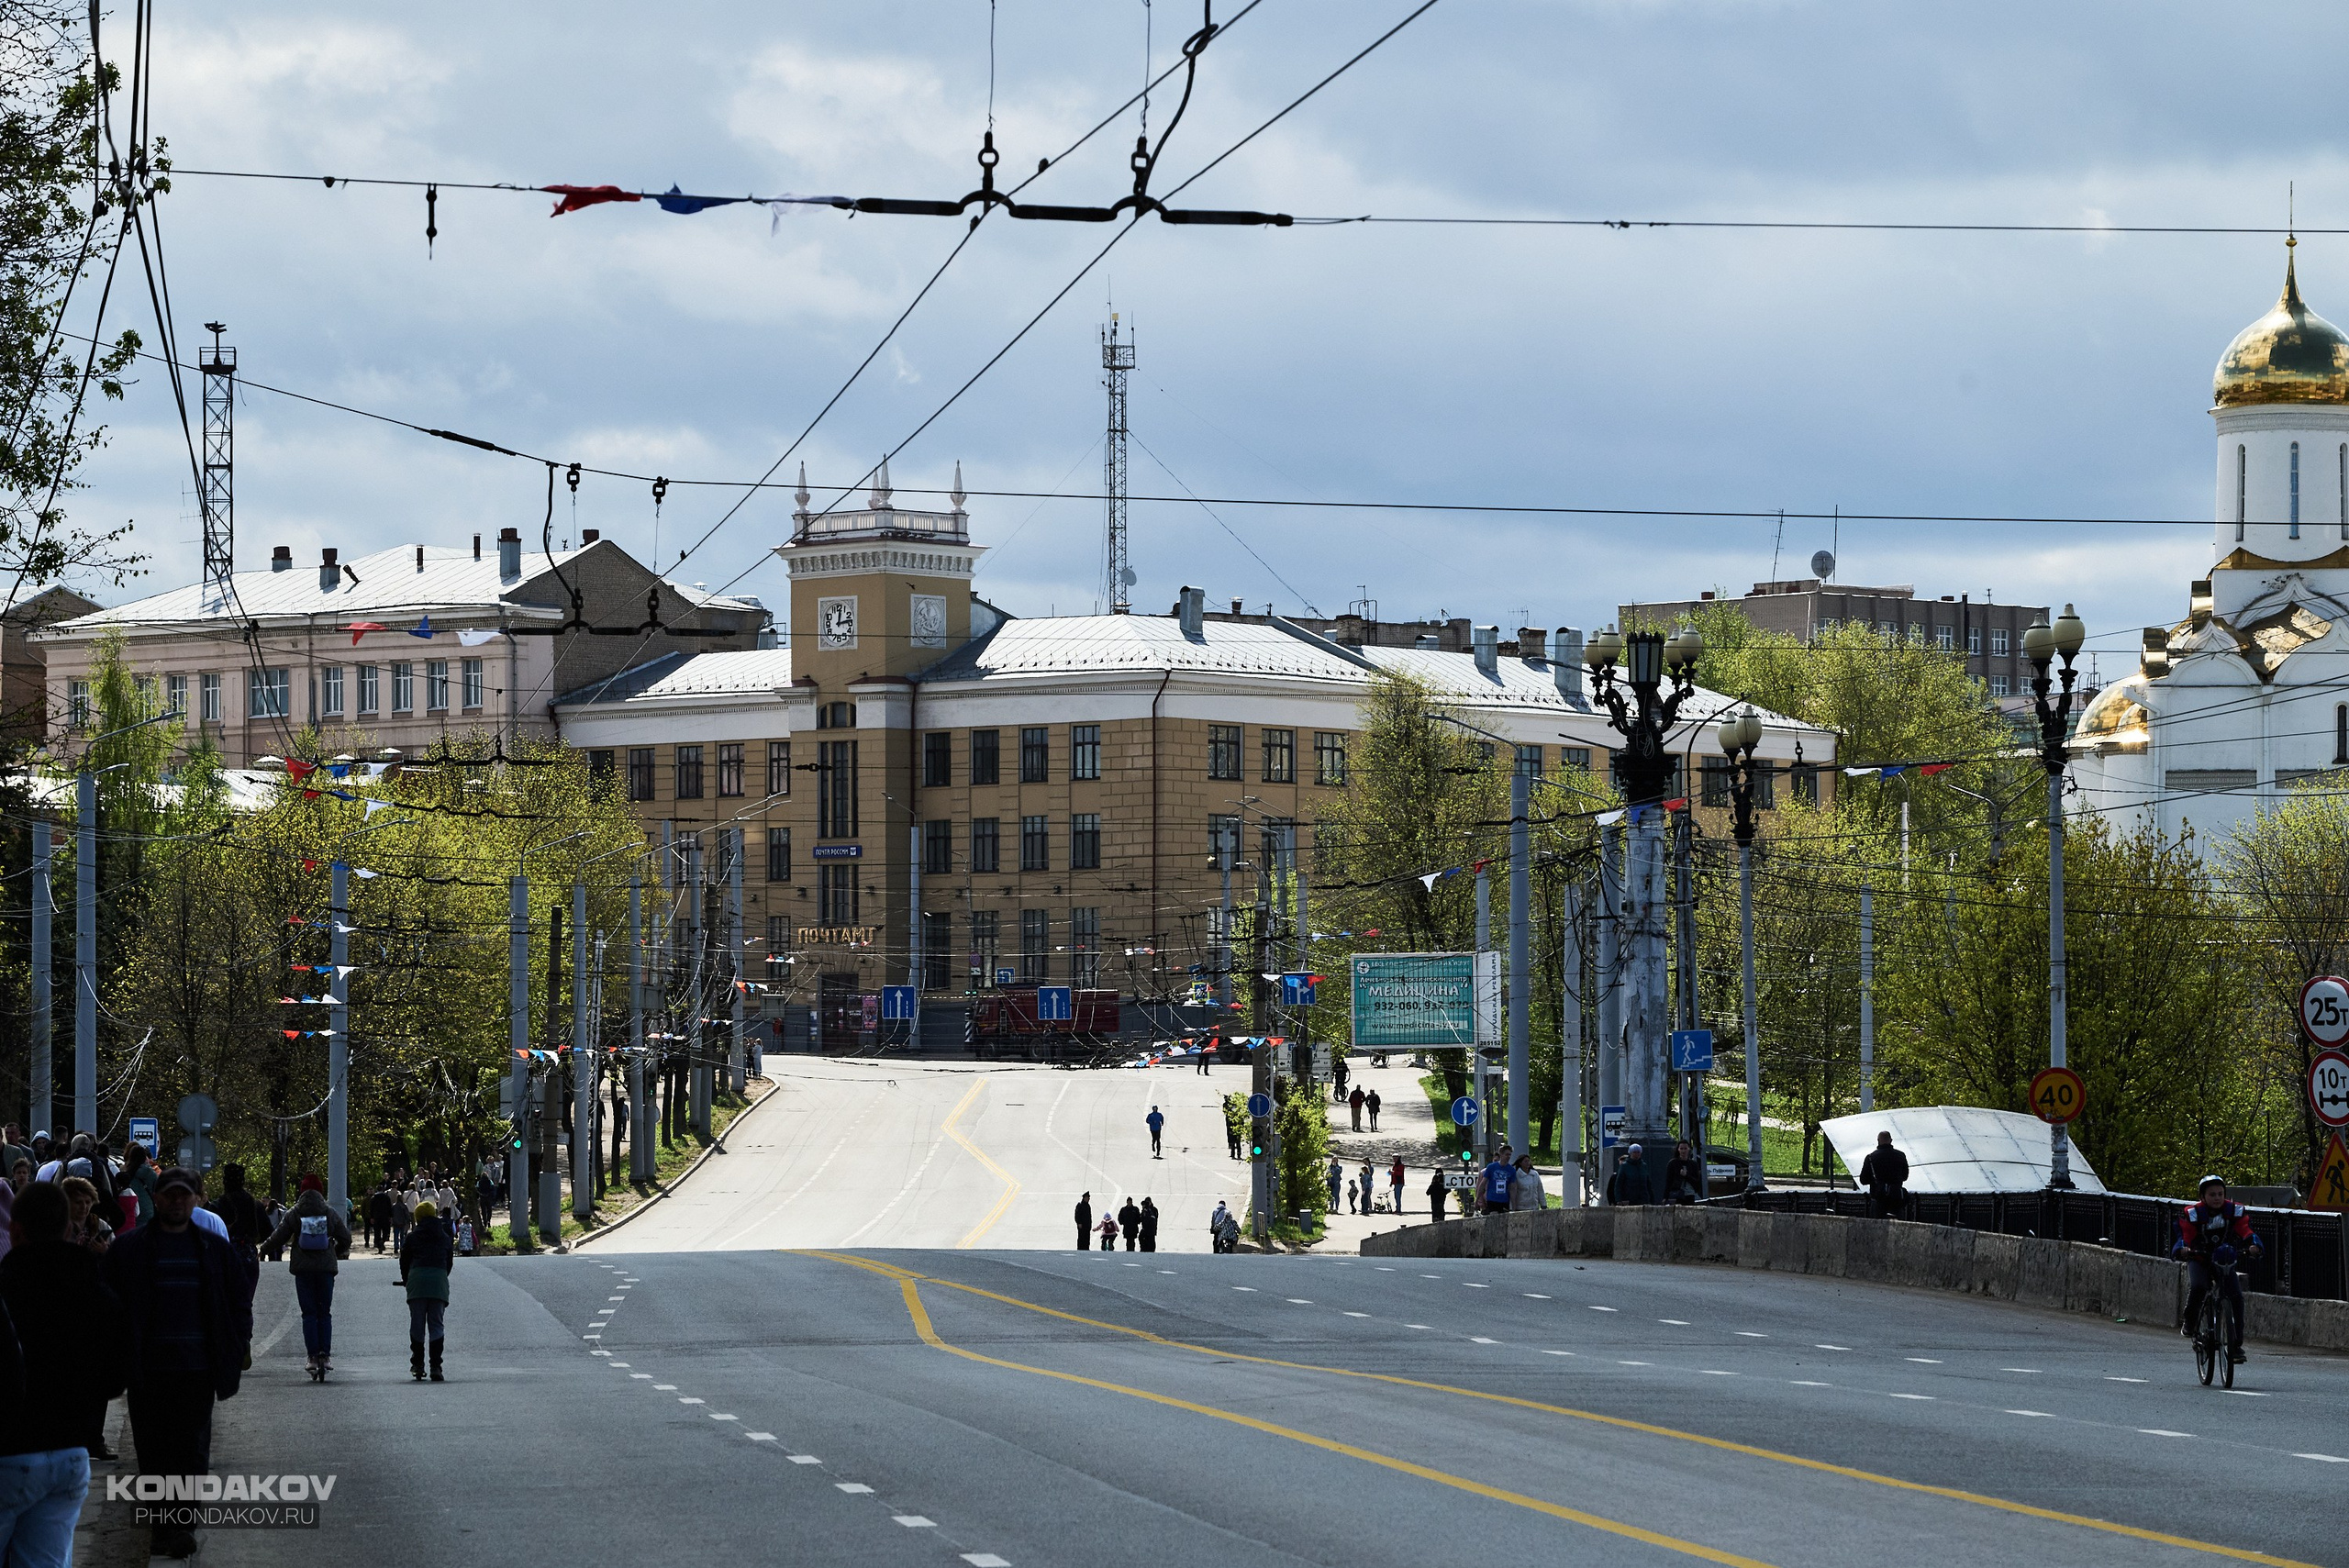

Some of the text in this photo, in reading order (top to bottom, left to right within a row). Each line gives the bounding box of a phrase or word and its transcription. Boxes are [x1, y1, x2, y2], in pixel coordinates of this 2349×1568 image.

[797, 927, 876, 944] ПОЧТАМТ
[1374, 1001, 1421, 1013] 932-060,
[2039, 1084, 2073, 1107] 40
